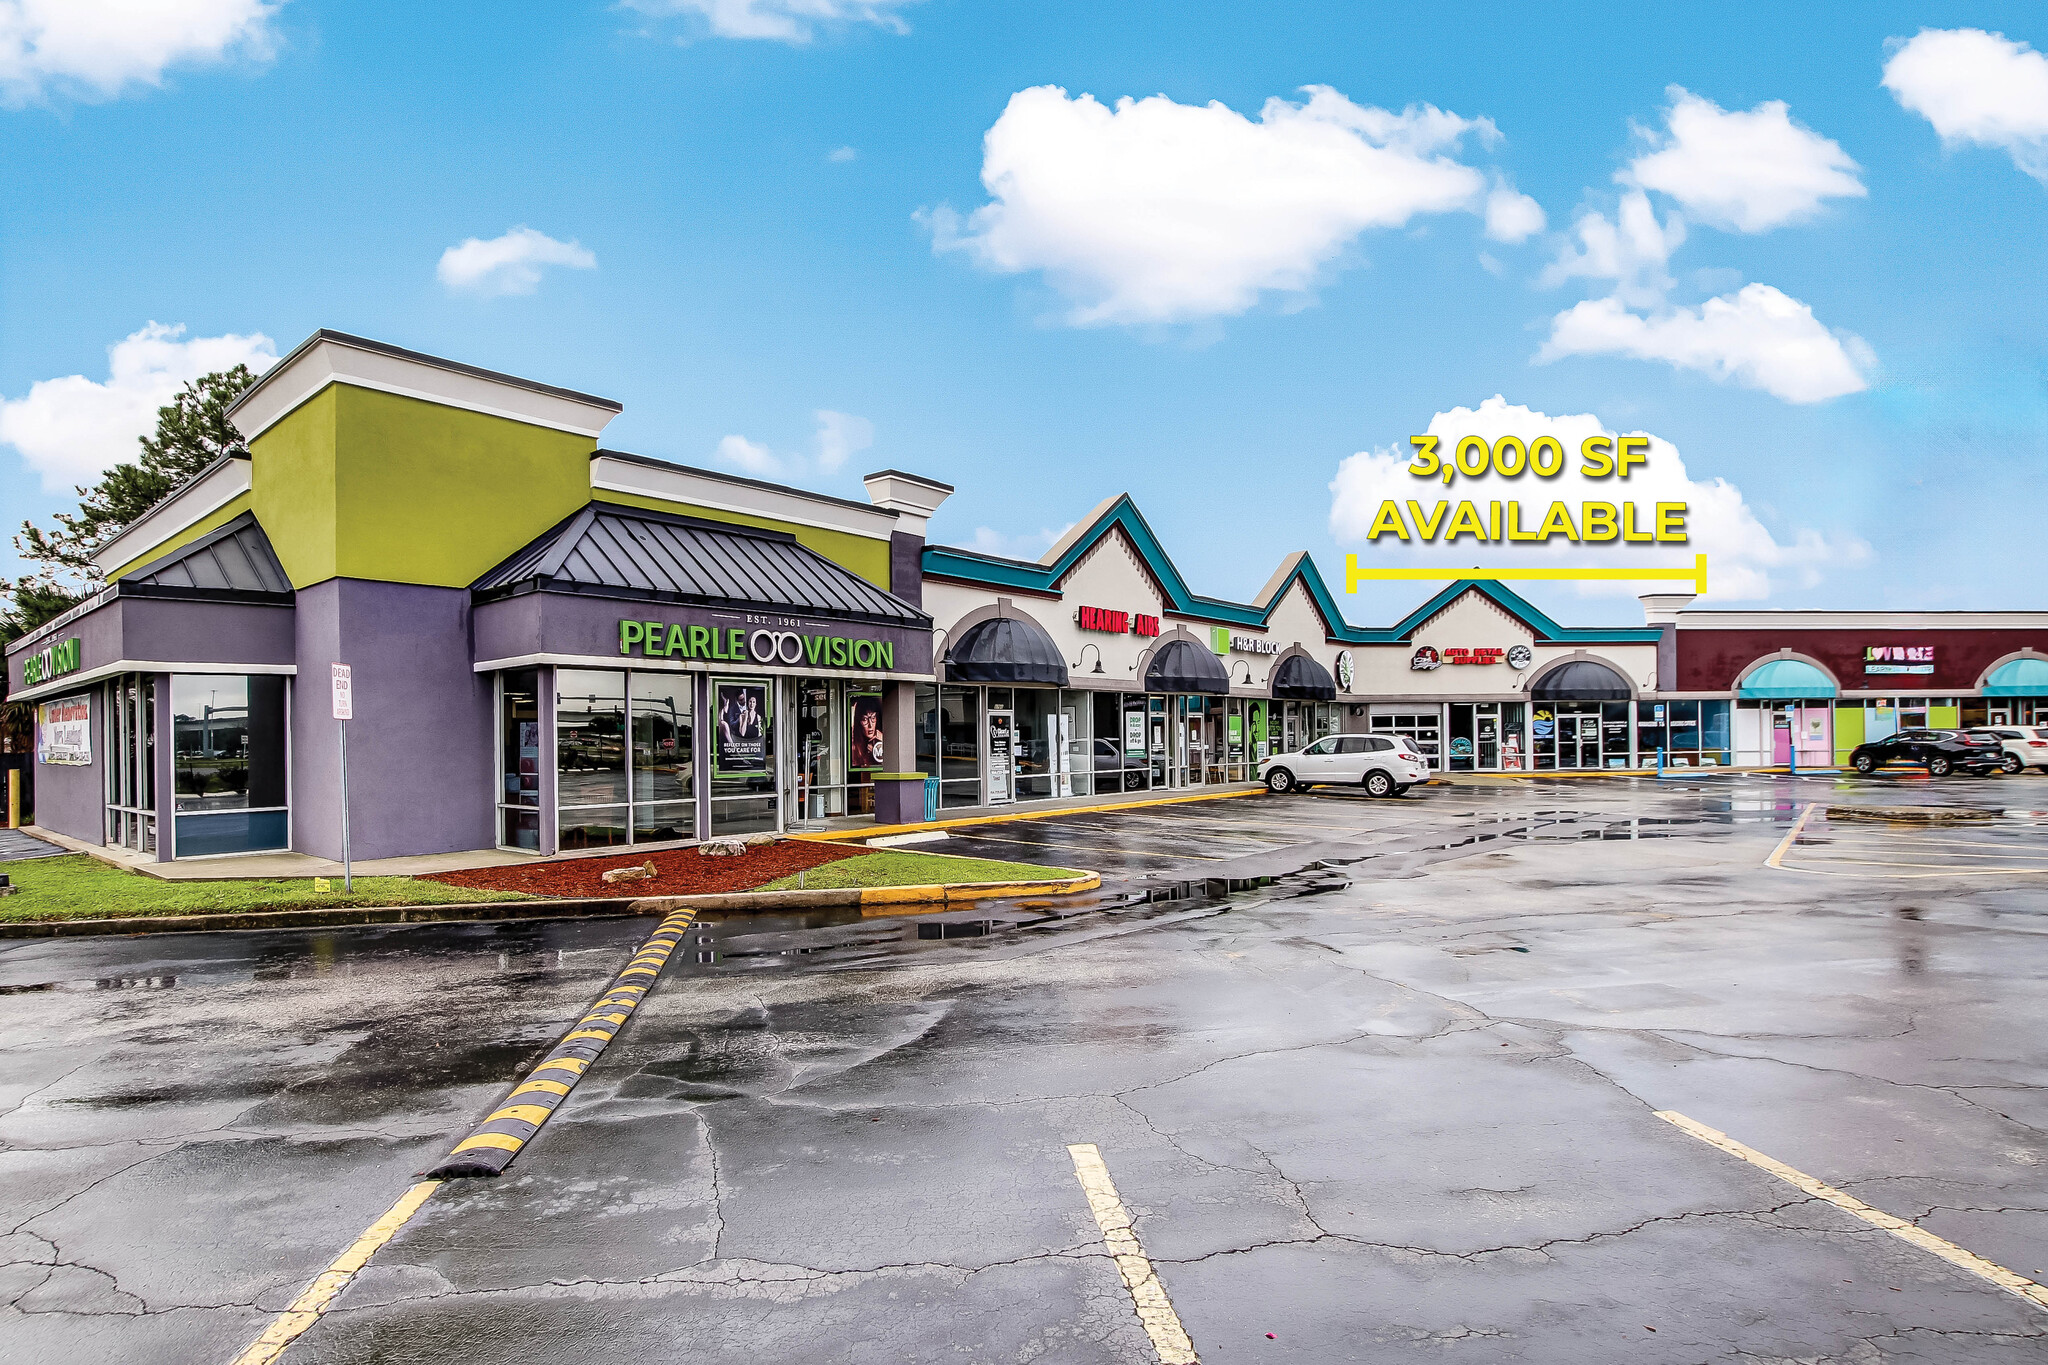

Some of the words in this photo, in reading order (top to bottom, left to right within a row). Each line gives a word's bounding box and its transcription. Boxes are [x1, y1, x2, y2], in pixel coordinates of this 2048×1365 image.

[746, 614, 771, 625] EST.
[778, 617, 801, 627] 1961
[1079, 606, 1128, 633] HEARING
[1135, 614, 1159, 637] AIDS
[619, 619, 746, 660] PEARLE
[803, 634, 894, 669] VISION
[1235, 637, 1255, 651] H&R
[1256, 640, 1281, 655] BLOCK
[1444, 648, 1469, 656] AUTO
[1474, 648, 1504, 656] DETAIL
[1453, 656, 1496, 665] SUPPLIES
[333, 667, 350, 678] DEAD
[336, 680, 348, 690] END
